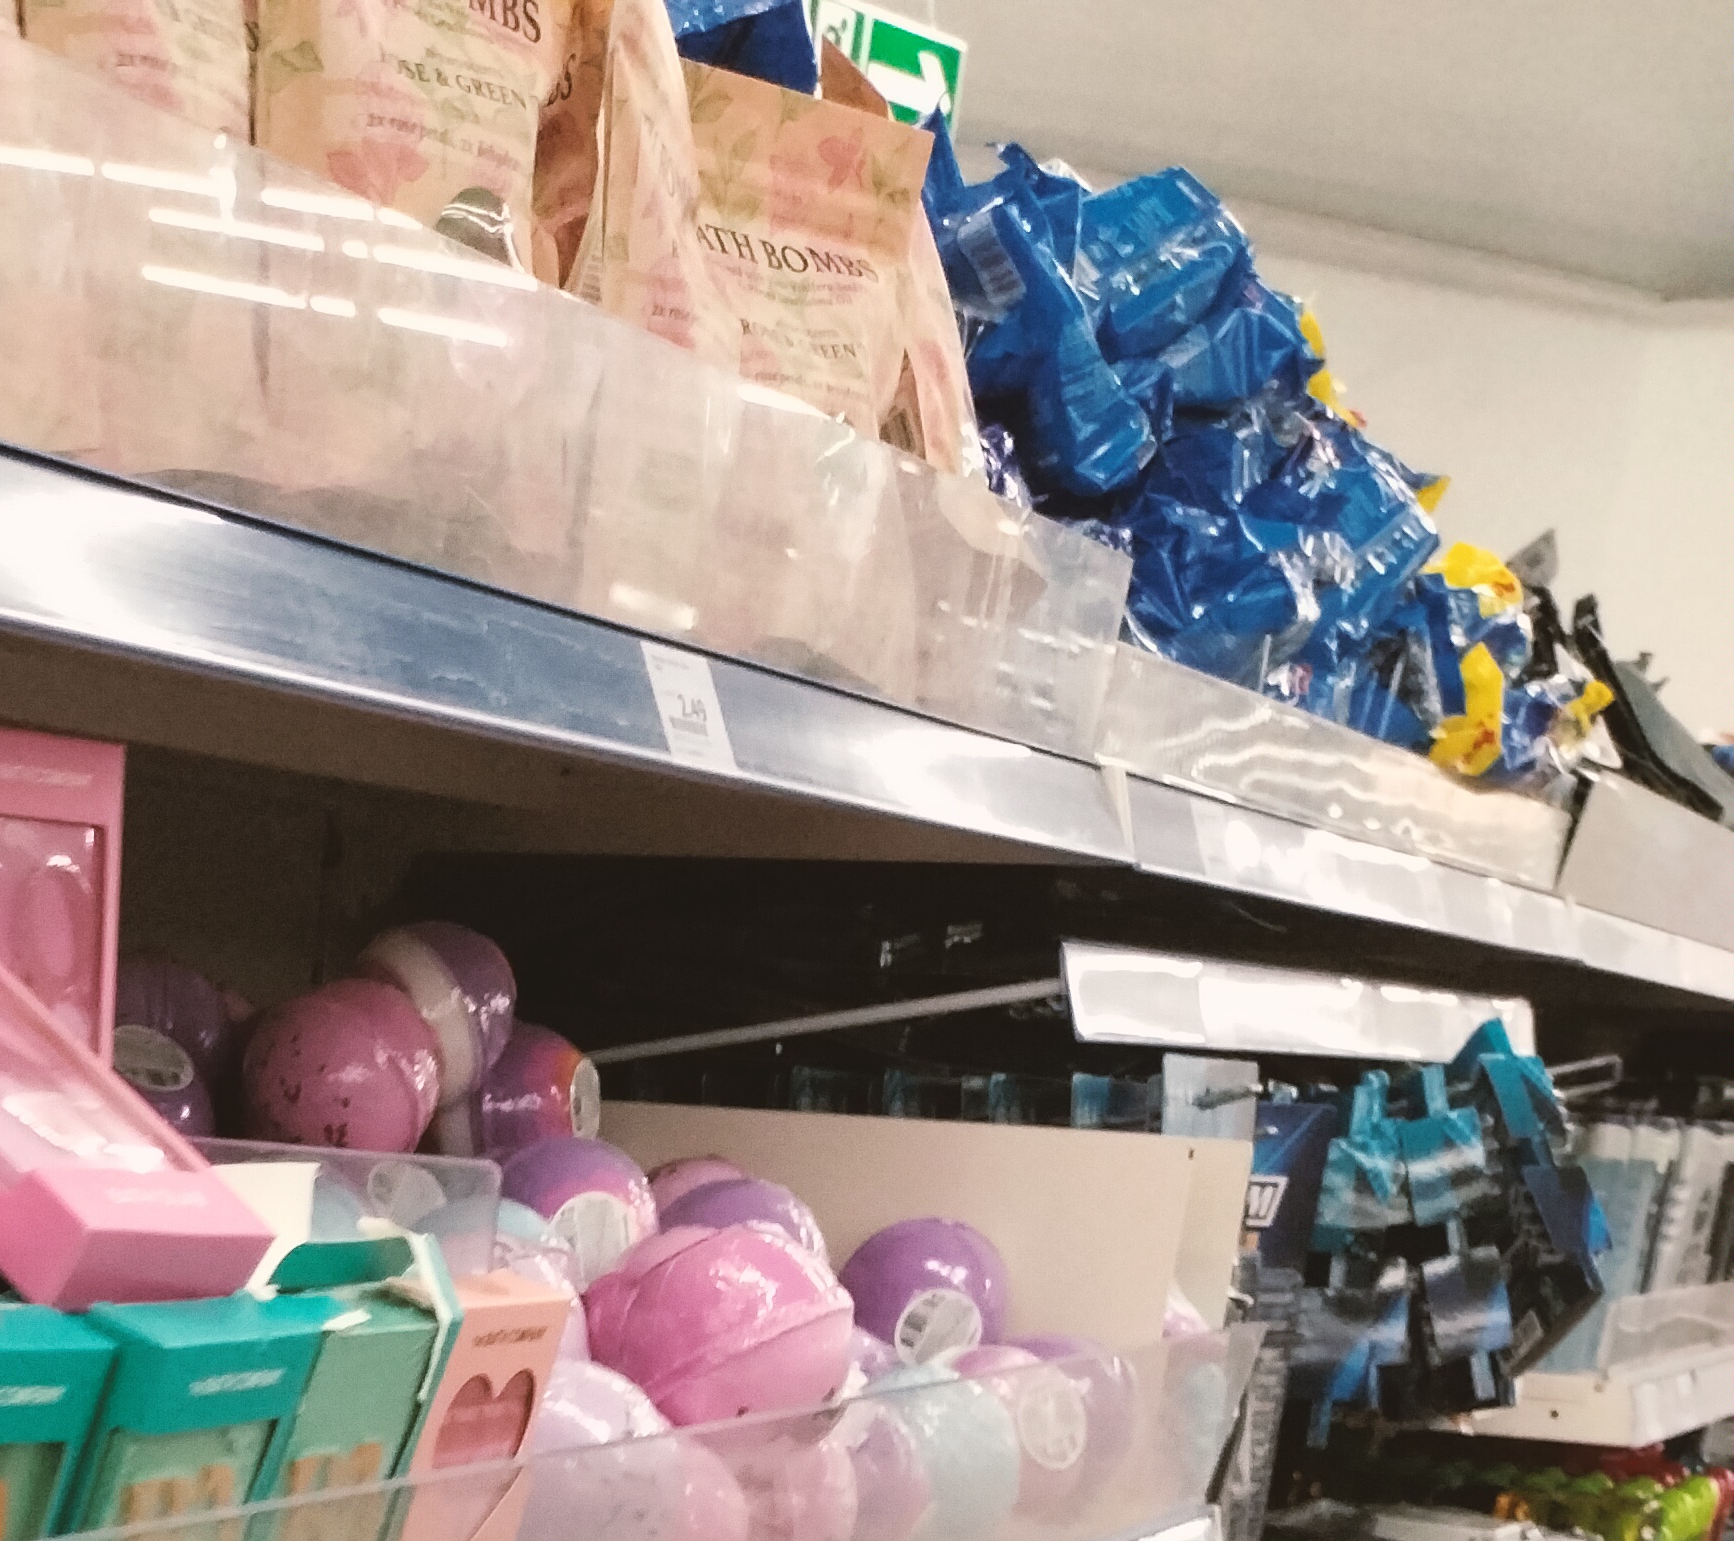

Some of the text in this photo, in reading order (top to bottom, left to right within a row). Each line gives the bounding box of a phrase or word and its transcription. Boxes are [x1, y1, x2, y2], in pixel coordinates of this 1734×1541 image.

[454, 73, 528, 110] GREEN
[696, 222, 879, 284] ATH BOMBS
